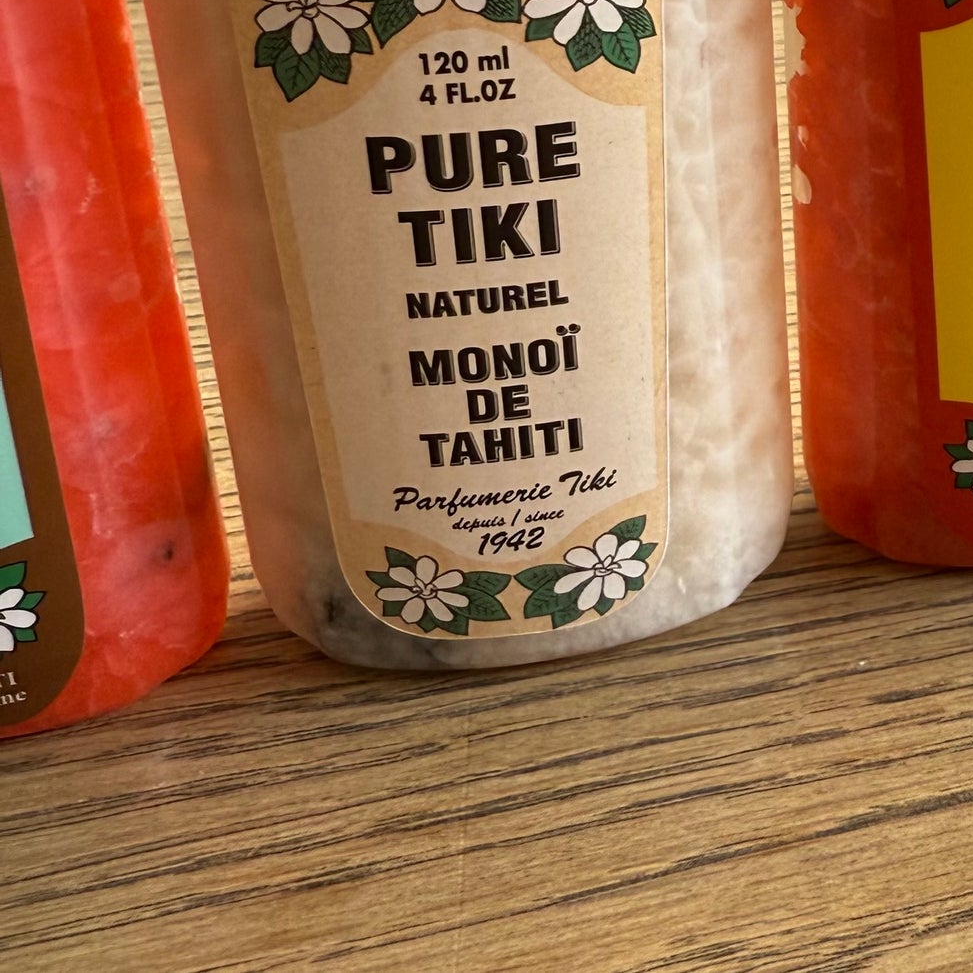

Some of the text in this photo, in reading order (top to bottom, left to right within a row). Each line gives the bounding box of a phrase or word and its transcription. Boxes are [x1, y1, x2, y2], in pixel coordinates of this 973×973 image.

[418, 46, 510, 77] 120 ml
[419, 78, 516, 105] 4 FL.OZ
[365, 121, 581, 194] PURE
[398, 198, 561, 266] TIKI
[405, 279, 569, 319] NATUREL
[408, 323, 581, 386] MONOÏ
[466, 384, 531, 424] DE
[419, 417, 583, 467] TAHITI
[393, 467, 617, 516] Parfumerie Tiki
[452, 516, 507, 532] depuis
[524, 509, 564, 524] since
[478, 526, 545, 556] 1942
